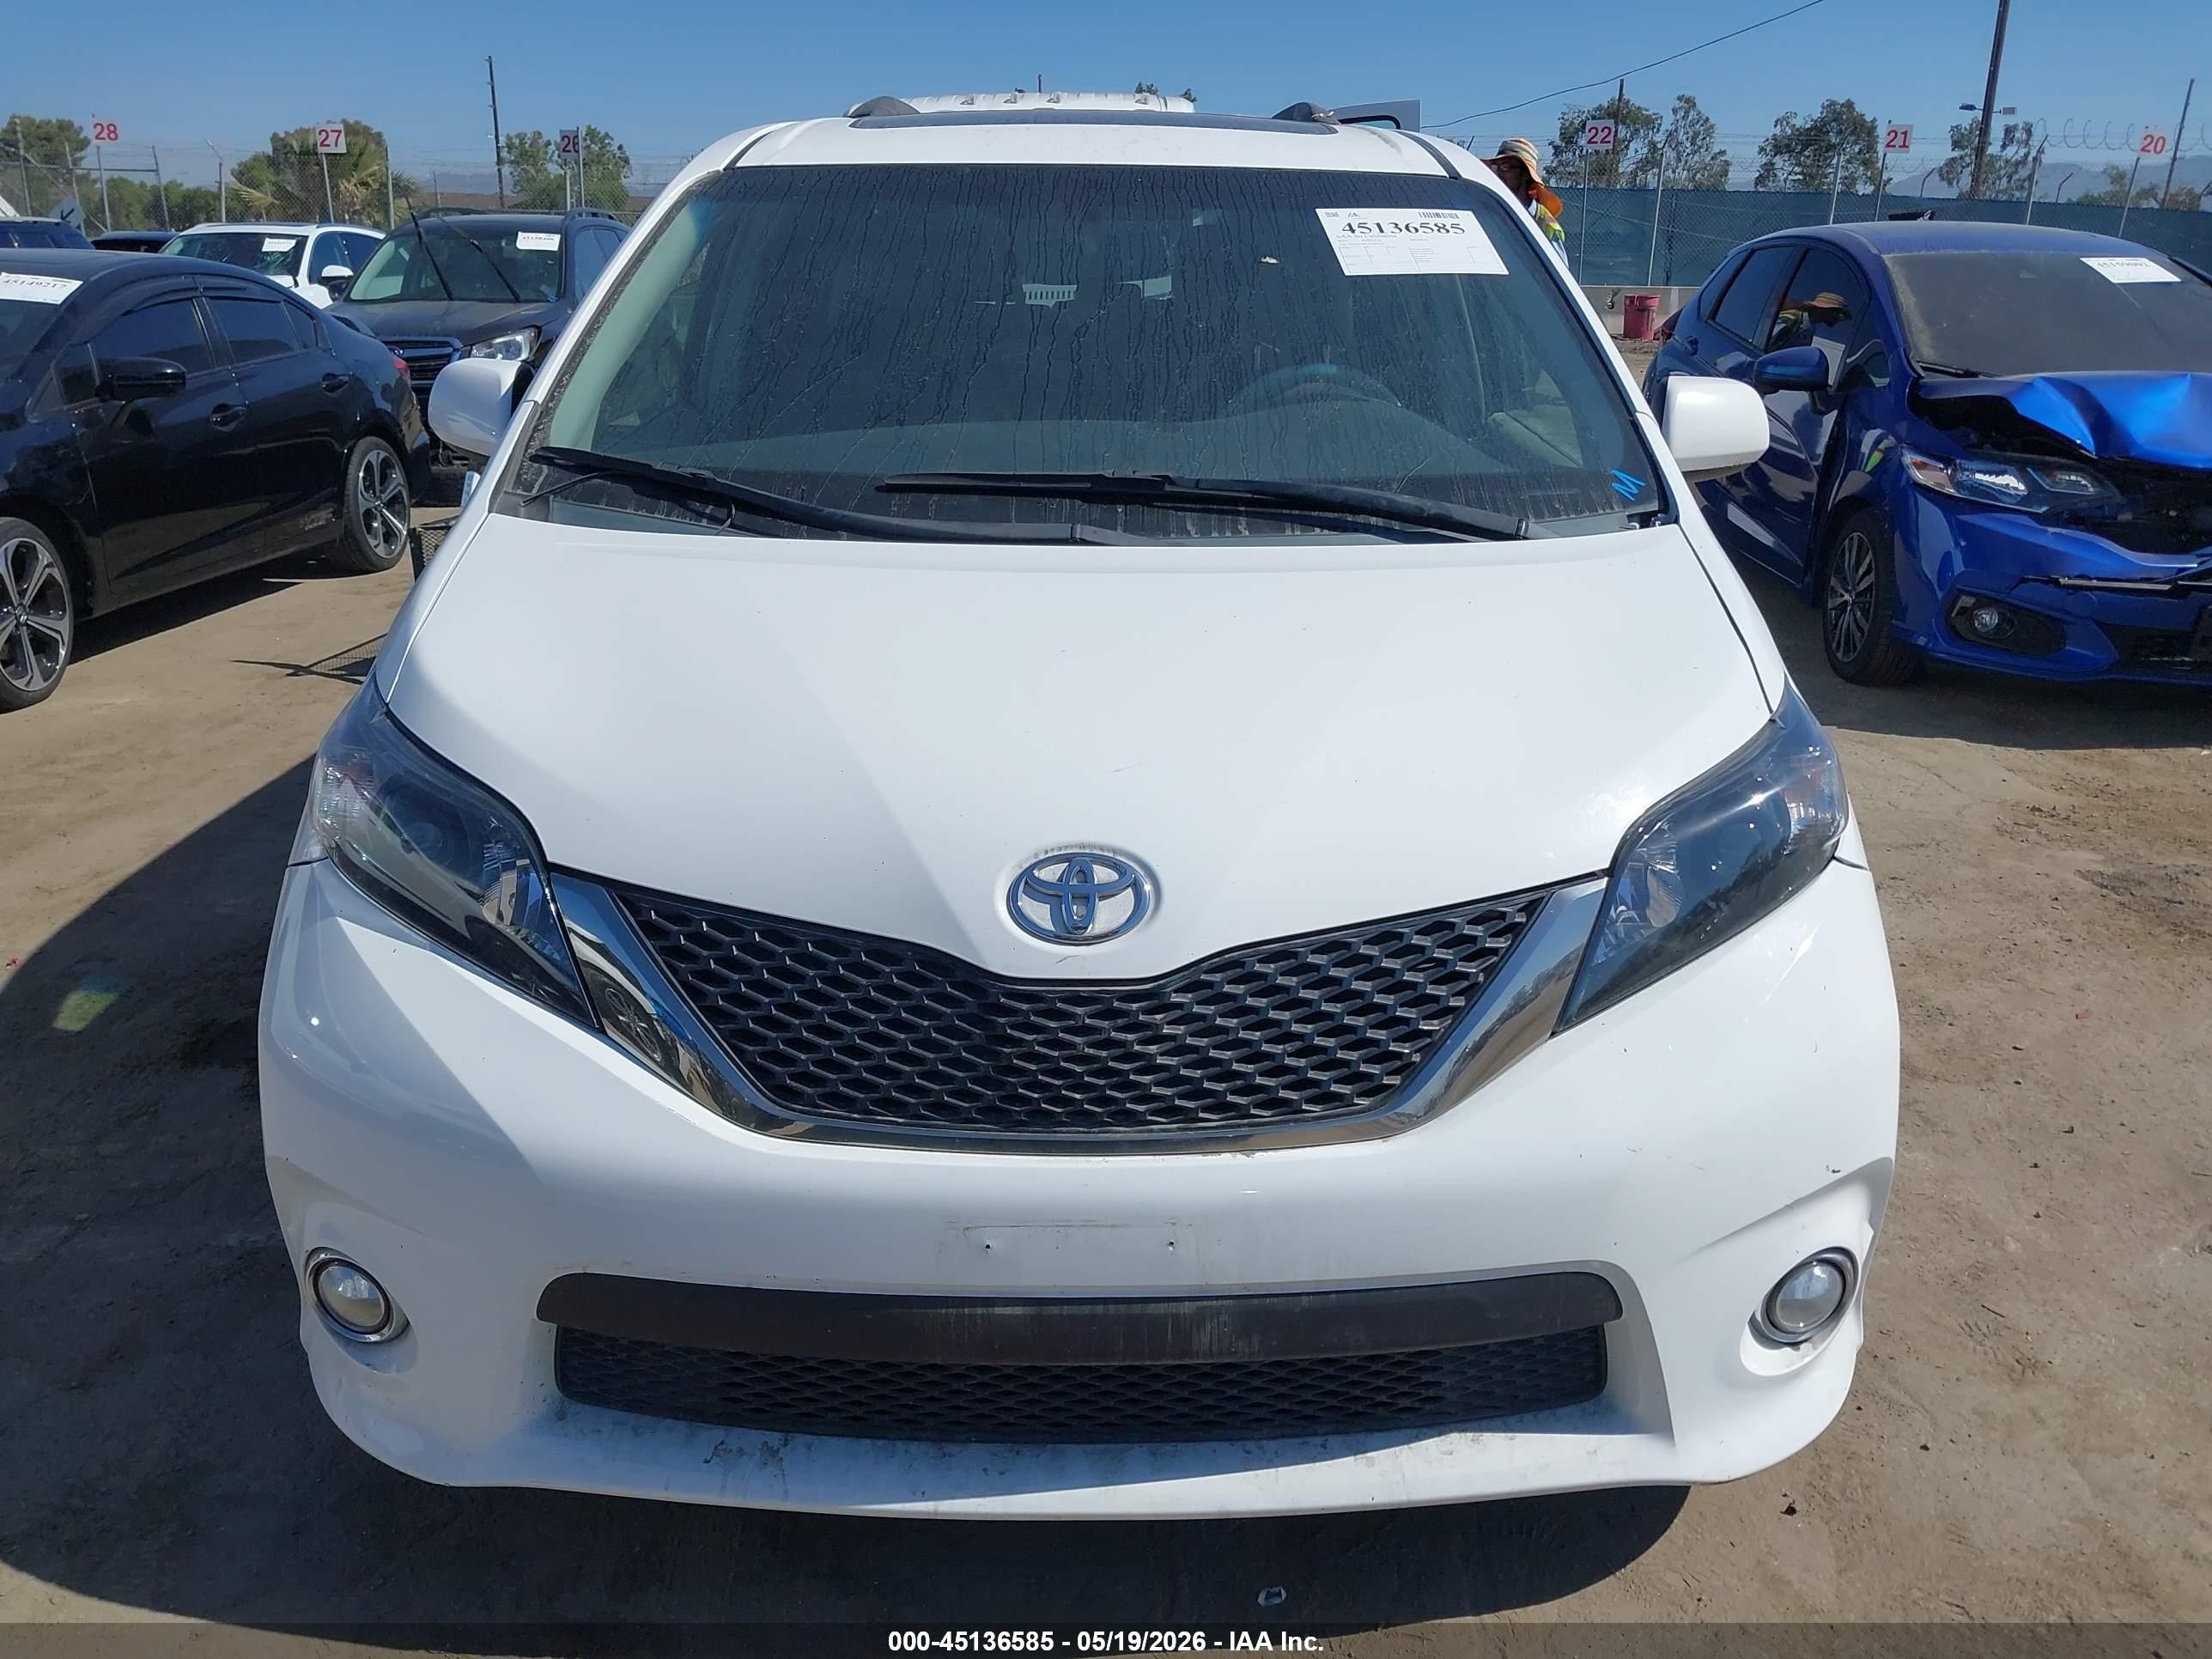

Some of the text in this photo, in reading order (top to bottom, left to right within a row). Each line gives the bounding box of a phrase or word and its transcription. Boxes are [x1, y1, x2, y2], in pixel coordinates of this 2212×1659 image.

[93, 122, 119, 142] 28
[318, 129, 343, 148] 27
[1586, 125, 1613, 145] 22
[1884, 129, 1910, 149] 21
[2139, 133, 2166, 155] 20
[1341, 221, 1466, 235] 45136585
